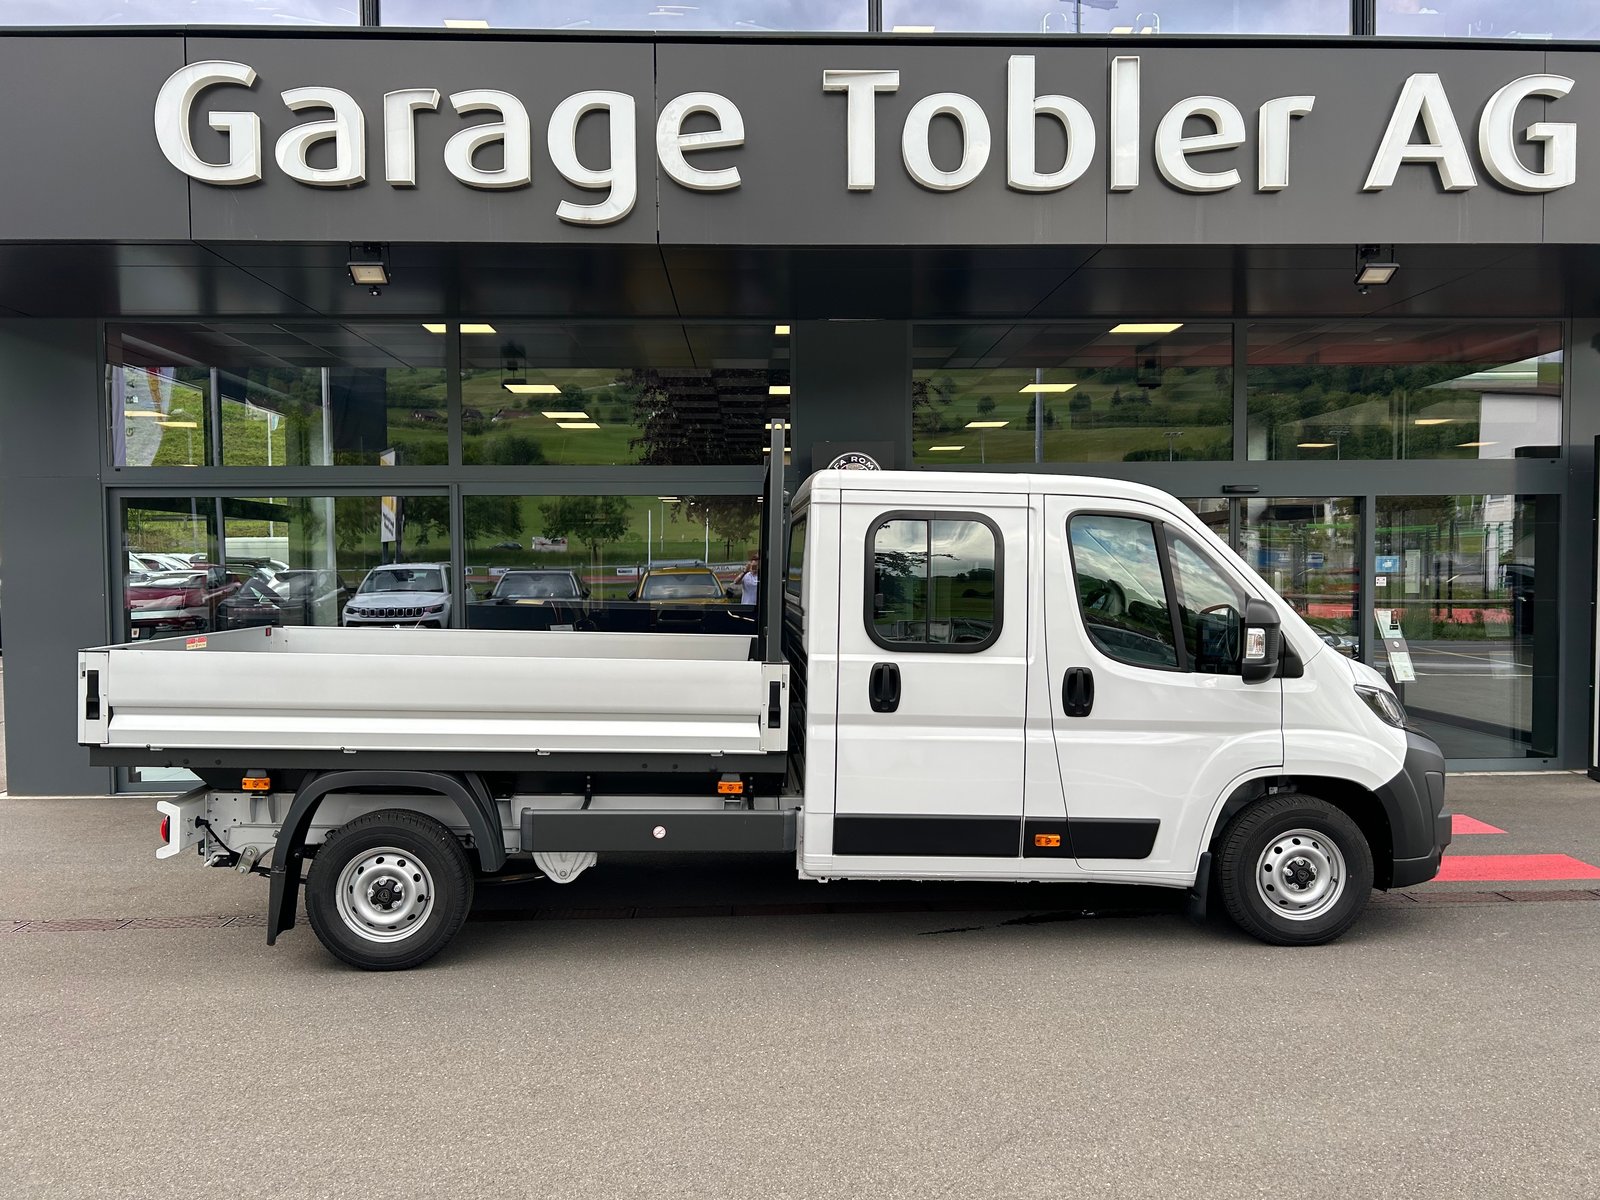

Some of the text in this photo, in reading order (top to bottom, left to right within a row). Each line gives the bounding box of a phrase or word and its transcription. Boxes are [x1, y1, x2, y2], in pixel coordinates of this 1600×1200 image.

[153, 55, 1578, 226] Garage Tobler AG
[850, 456, 877, 471] ROM
